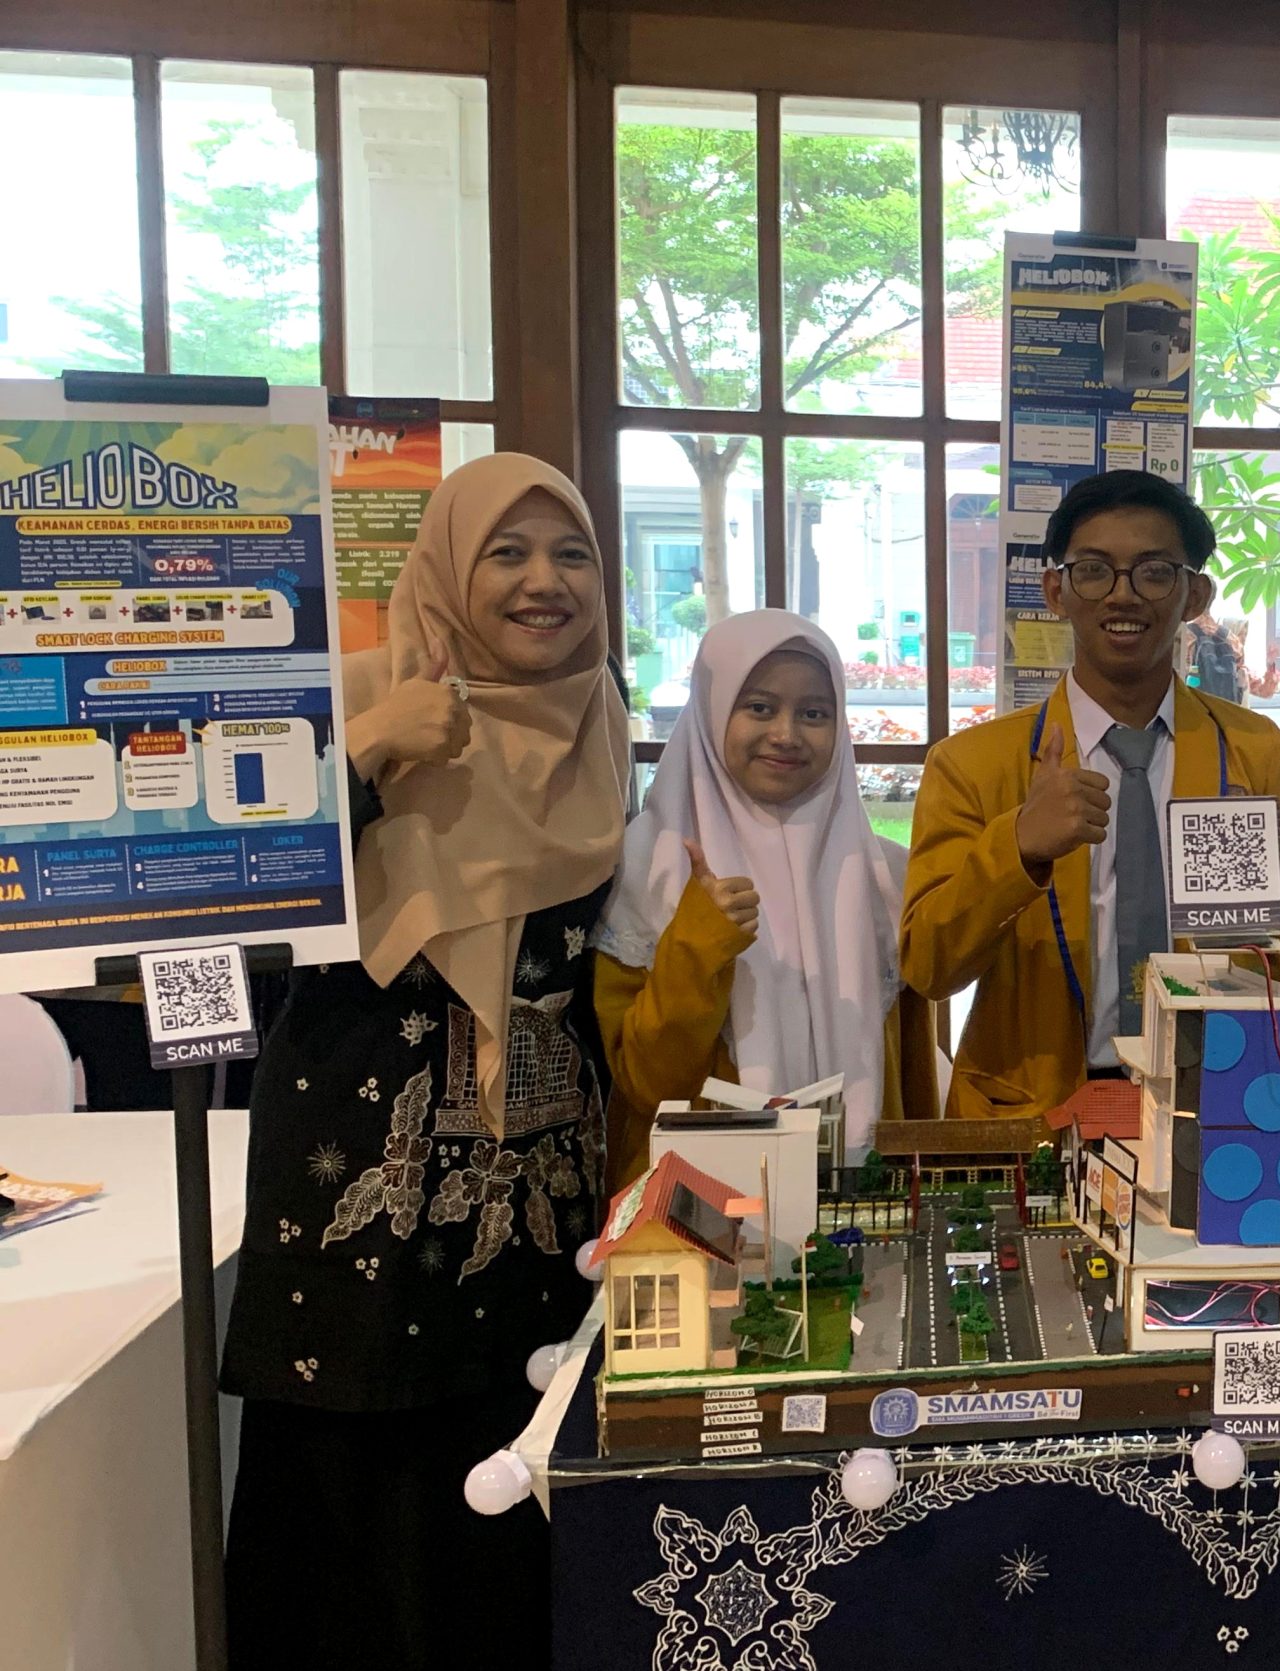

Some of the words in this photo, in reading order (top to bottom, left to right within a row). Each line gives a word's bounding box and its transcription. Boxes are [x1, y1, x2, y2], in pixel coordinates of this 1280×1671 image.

[1018, 268, 1110, 286] HELIOBOX
[328, 423, 397, 455] AHAN
[1150, 458, 1167, 474] Rp
[1170, 459, 1179, 472] 0
[0, 442, 238, 510] HELIOBOX
[18, 521, 83, 530] KEAMANAN
[139, 520, 178, 530] ENERGI
[181, 520, 219, 530] BERSIH
[222, 520, 255, 530] TANPA
[258, 520, 289, 530] BATAS
[154, 559, 214, 574] 0,79%
[1010, 556, 1056, 573] HELI
[36, 633, 78, 647] SMART
[80, 632, 113, 646] LOCK
[114, 631, 177, 645] CHARGING
[178, 629, 225, 643] SYSTEM
[112, 660, 167, 673] HELIOBOX
[40, 733, 88, 743] HELIOBOX
[222, 723, 262, 737] HEMAT
[1187, 909, 1238, 926] SCAN
[1244, 907, 1271, 923] ME
[166, 1041, 213, 1061] SCAN
[218, 1038, 244, 1055] ME
[927, 1391, 1081, 1413] SMAMSATU
[1223, 1420, 1264, 1434] SCAN
